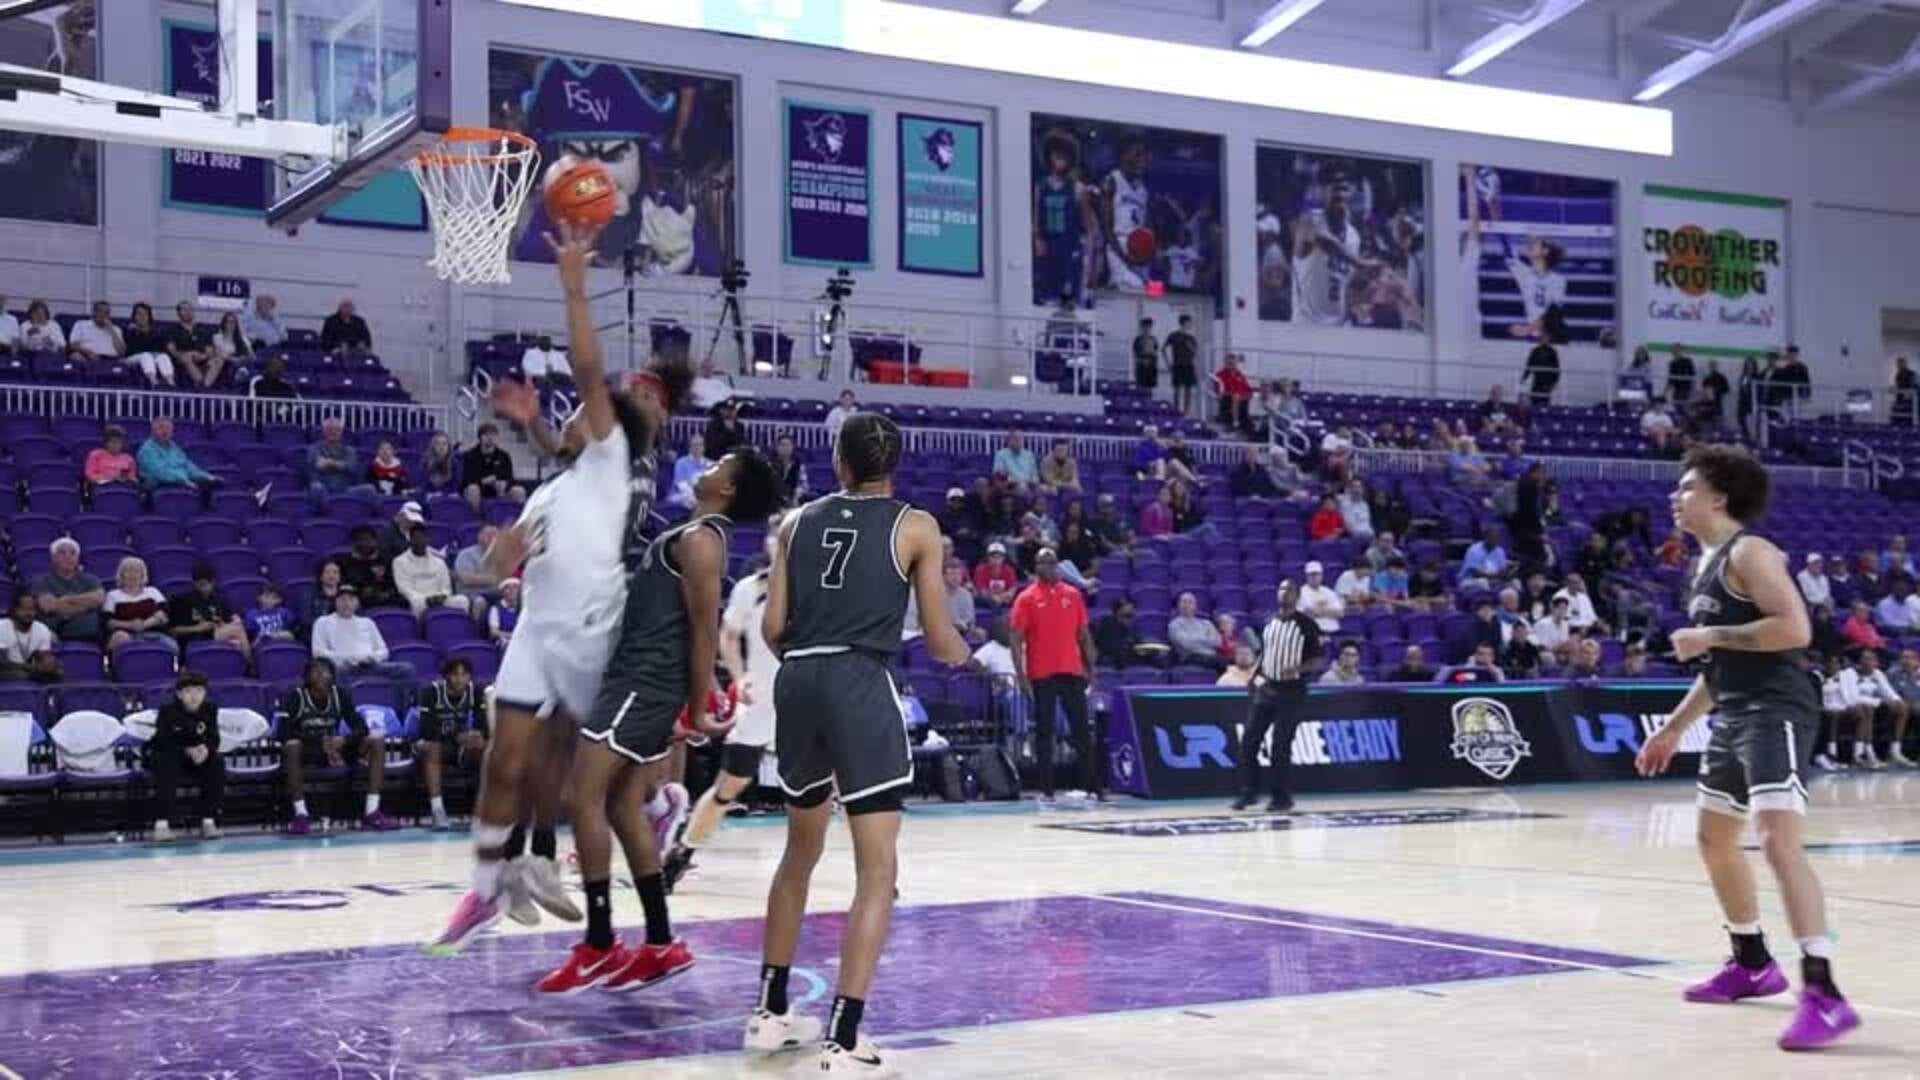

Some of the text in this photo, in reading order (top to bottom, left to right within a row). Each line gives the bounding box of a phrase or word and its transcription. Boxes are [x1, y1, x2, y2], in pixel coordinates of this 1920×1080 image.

[563, 80, 611, 123] FSW
[1643, 227, 1779, 267] CROWTHER
[217, 281, 241, 295] 116
[1653, 260, 1767, 295] ROOFING
[821, 527, 858, 588] 7
[1153, 723, 1236, 768] UR
[1573, 712, 1643, 753] UR
